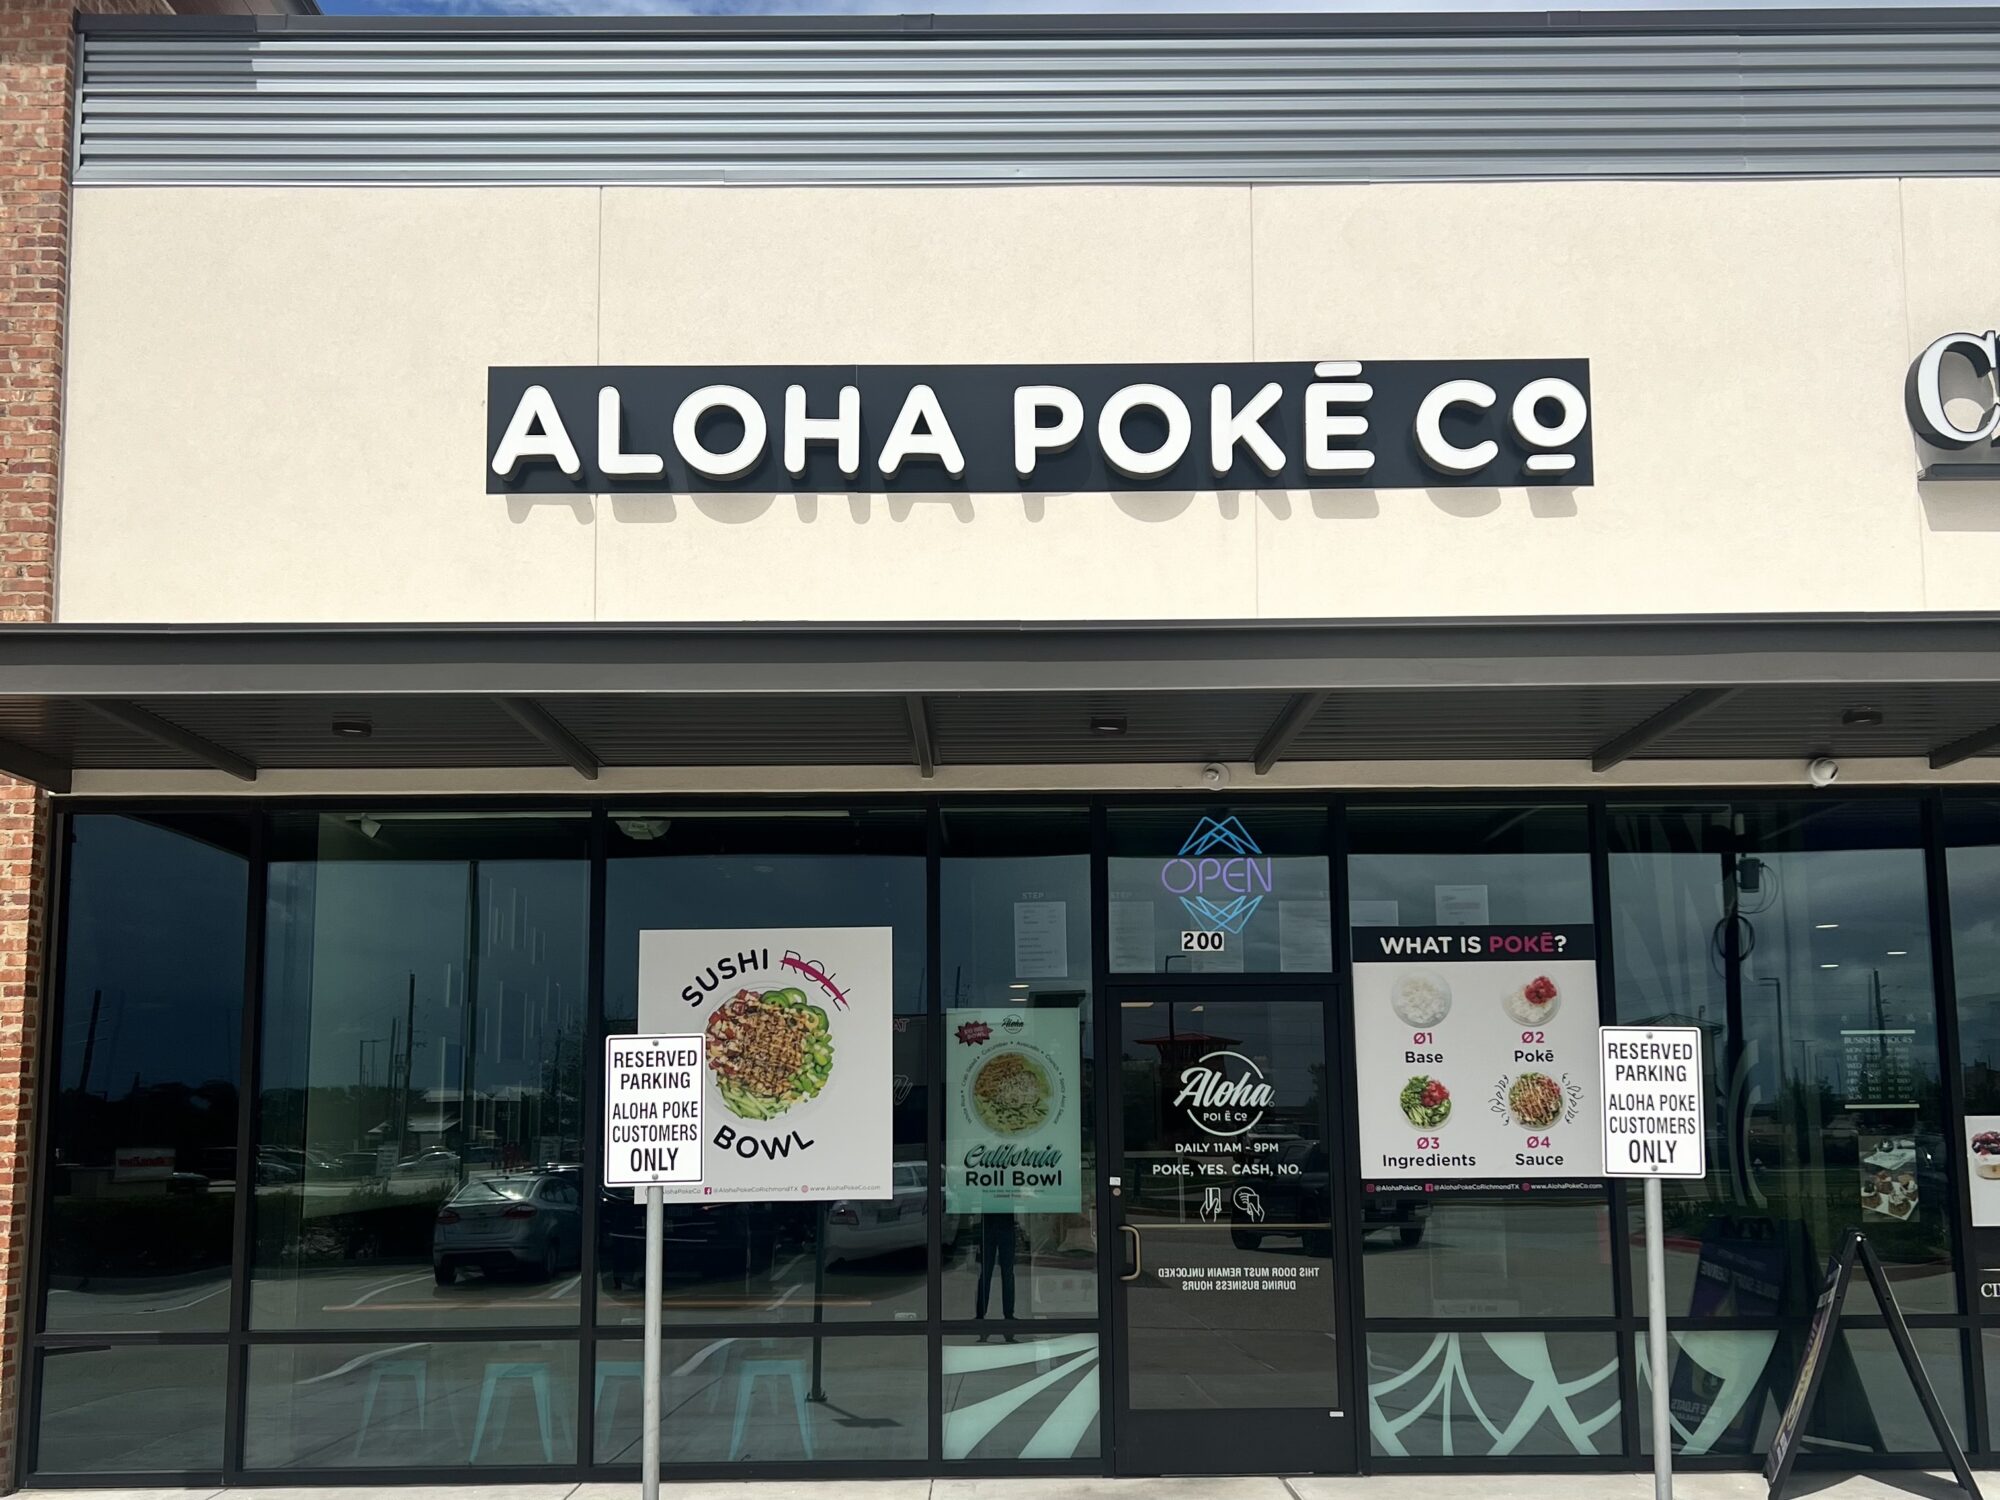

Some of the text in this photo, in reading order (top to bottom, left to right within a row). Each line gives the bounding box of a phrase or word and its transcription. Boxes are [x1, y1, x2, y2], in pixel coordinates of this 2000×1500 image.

[1905, 330, 2000, 450] C
[490, 383, 966, 480] ALOHA
[1161, 857, 1272, 894] OPEN
[1183, 931, 1223, 950] 200
[1380, 936, 1453, 955] WHAT
[1460, 936, 1482, 954] IS
[681, 948, 851, 1012] SUSHI ROLL
[1844, 1036, 1880, 1044] BUSINESS
[614, 1049, 698, 1068] RESERVED
[1405, 1050, 1444, 1064] Base
[1608, 1042, 1693, 1060] RESERVED
[621, 1072, 691, 1090] PARKING
[1616, 1064, 1687, 1082] PARKING
[1172, 1066, 1275, 1107] Aloha
[612, 1101, 698, 1120] ALOHA POKE
[1609, 1093, 1696, 1112] ALOHA POKE
[612, 1124, 698, 1143] CUSTOMERS
[1609, 1116, 1696, 1134] CUSTOMERS
[713, 1124, 815, 1160] BOWL
[1175, 1143, 1210, 1153] DAILY
[1213, 1143, 1242, 1153] 11AM
[1254, 1142, 1279, 1153] 9PM
[1629, 1139, 1677, 1163] ONLY
[630, 1147, 679, 1172] ONLY
[964, 1144, 1063, 1170] California
[1382, 1154, 1476, 1169] Ingredients
[1515, 1153, 1564, 1166] Sauce
[966, 1170, 1062, 1186] Roll Bowl
[1152, 1164, 1303, 1177] POKE, YES. CASH, NO.
[810, 1184, 881, 1193] www.AlohaPokeCo.com
[1375, 1181, 1603, 1192] @AlohaPokeCo @AlohaPokeCoRichmondTX www.AlohaPokeCo.com
